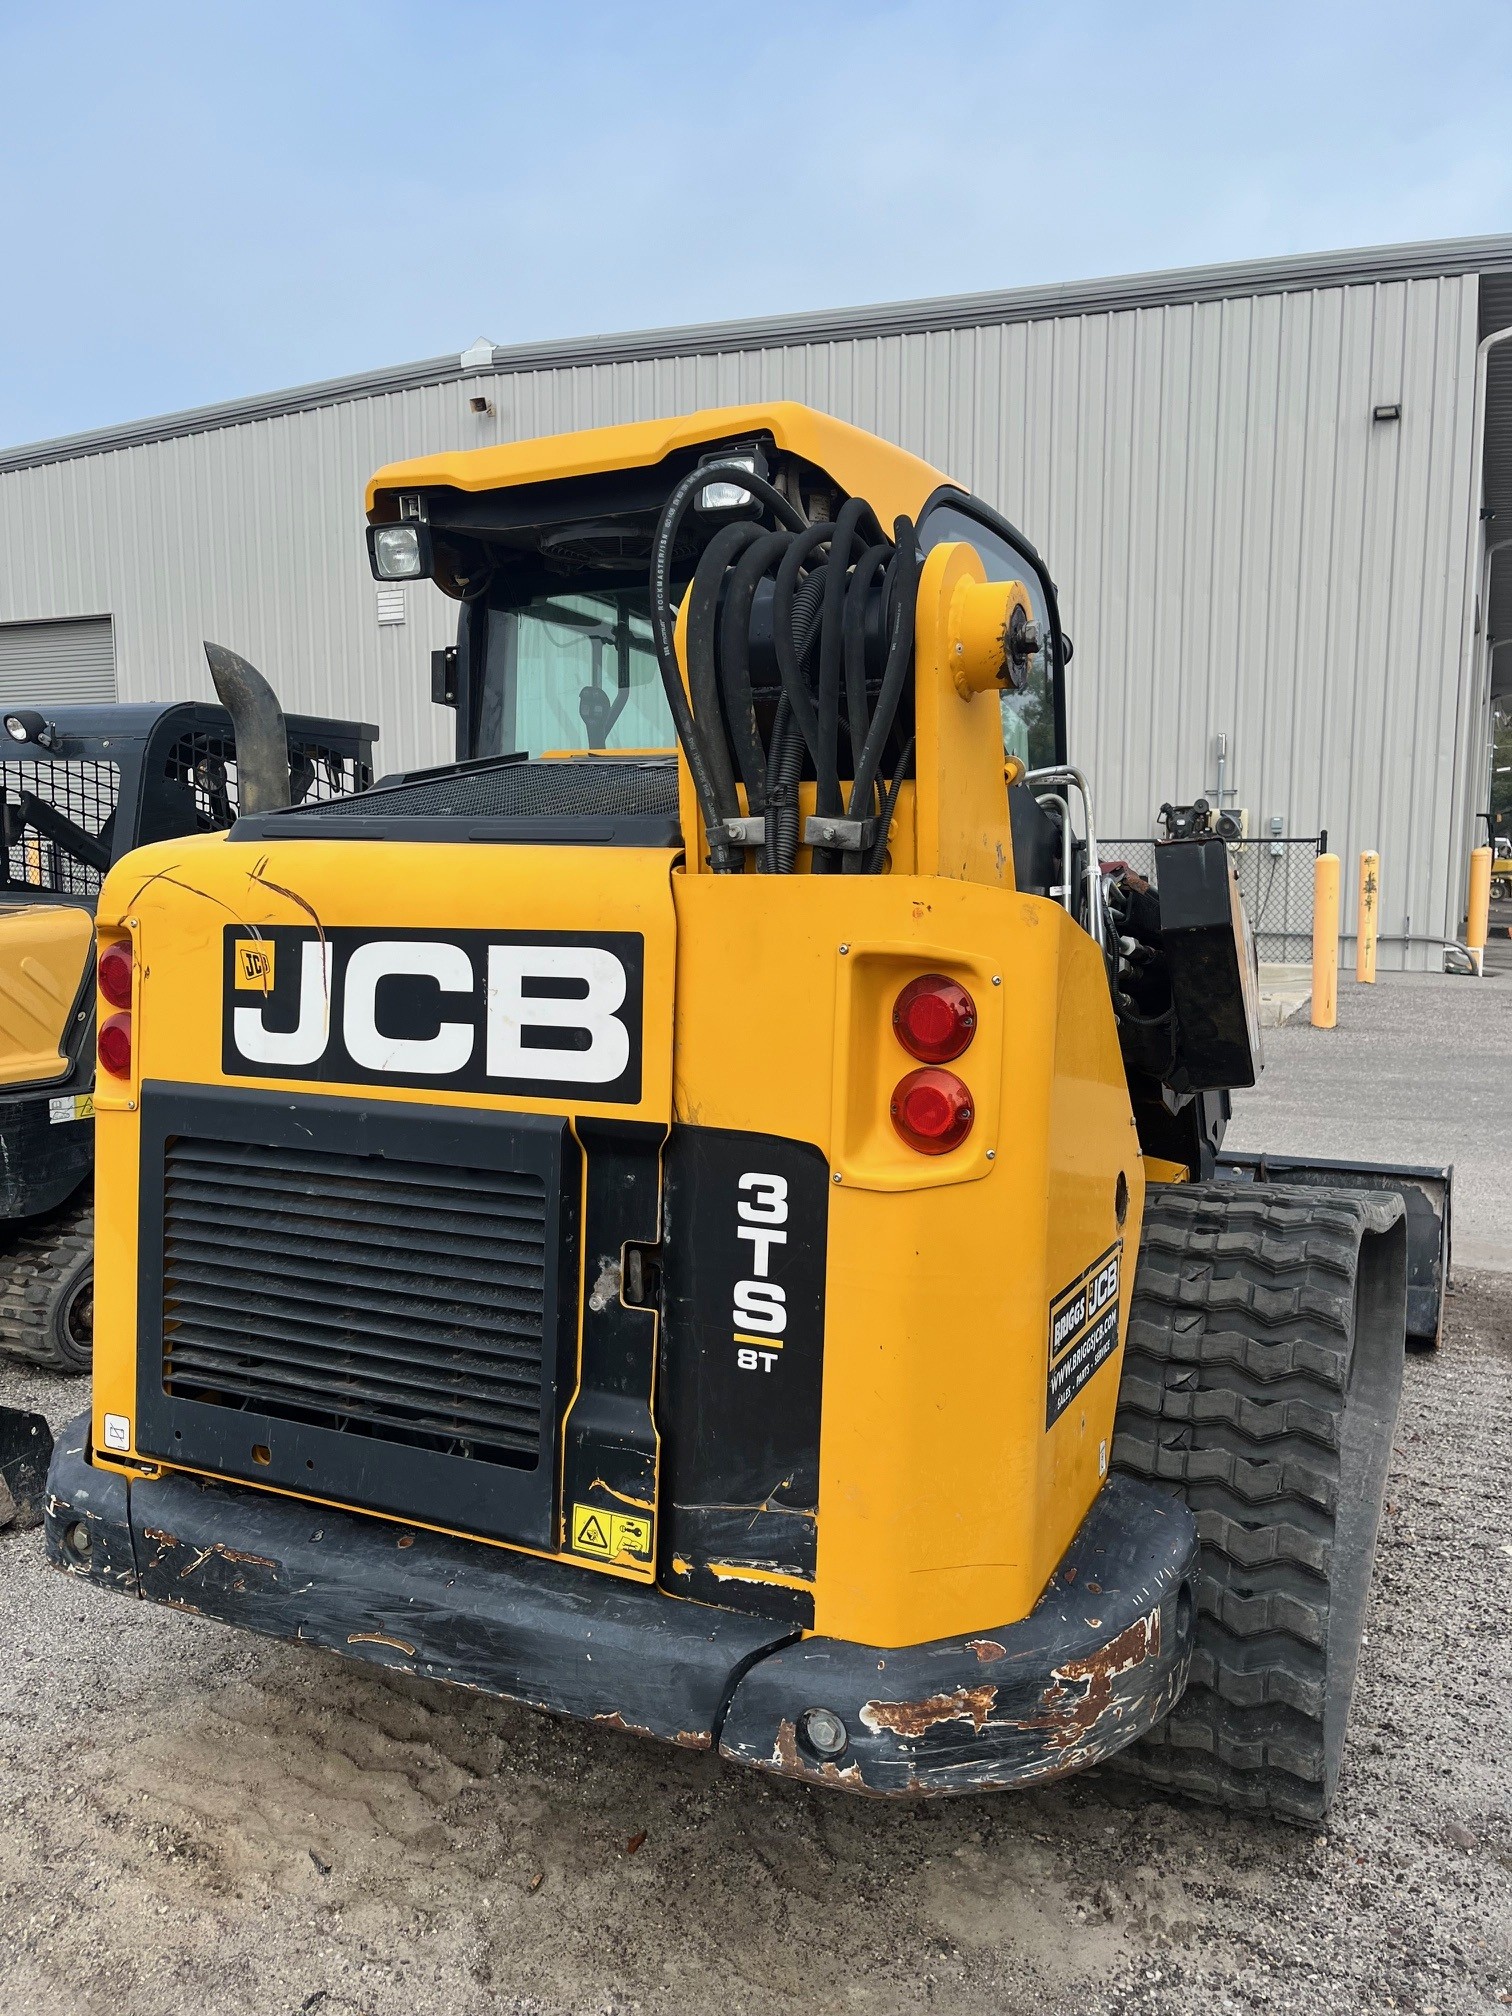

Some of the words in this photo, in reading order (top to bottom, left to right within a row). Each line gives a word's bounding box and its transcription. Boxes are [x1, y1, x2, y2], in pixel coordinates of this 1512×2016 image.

[233, 940, 630, 1084] JCB
[1054, 1296, 1085, 1347] BRIGGS
[1088, 1260, 1118, 1316] JCB
[737, 1348, 778, 1373] 8T
[1051, 1308, 1117, 1395] WWW.BRIGGSJCB.COM
[1057, 1384, 1071, 1410] SALES
[1076, 1363, 1090, 1388] PARTS
[1094, 1339, 1111, 1367] SERVICE
